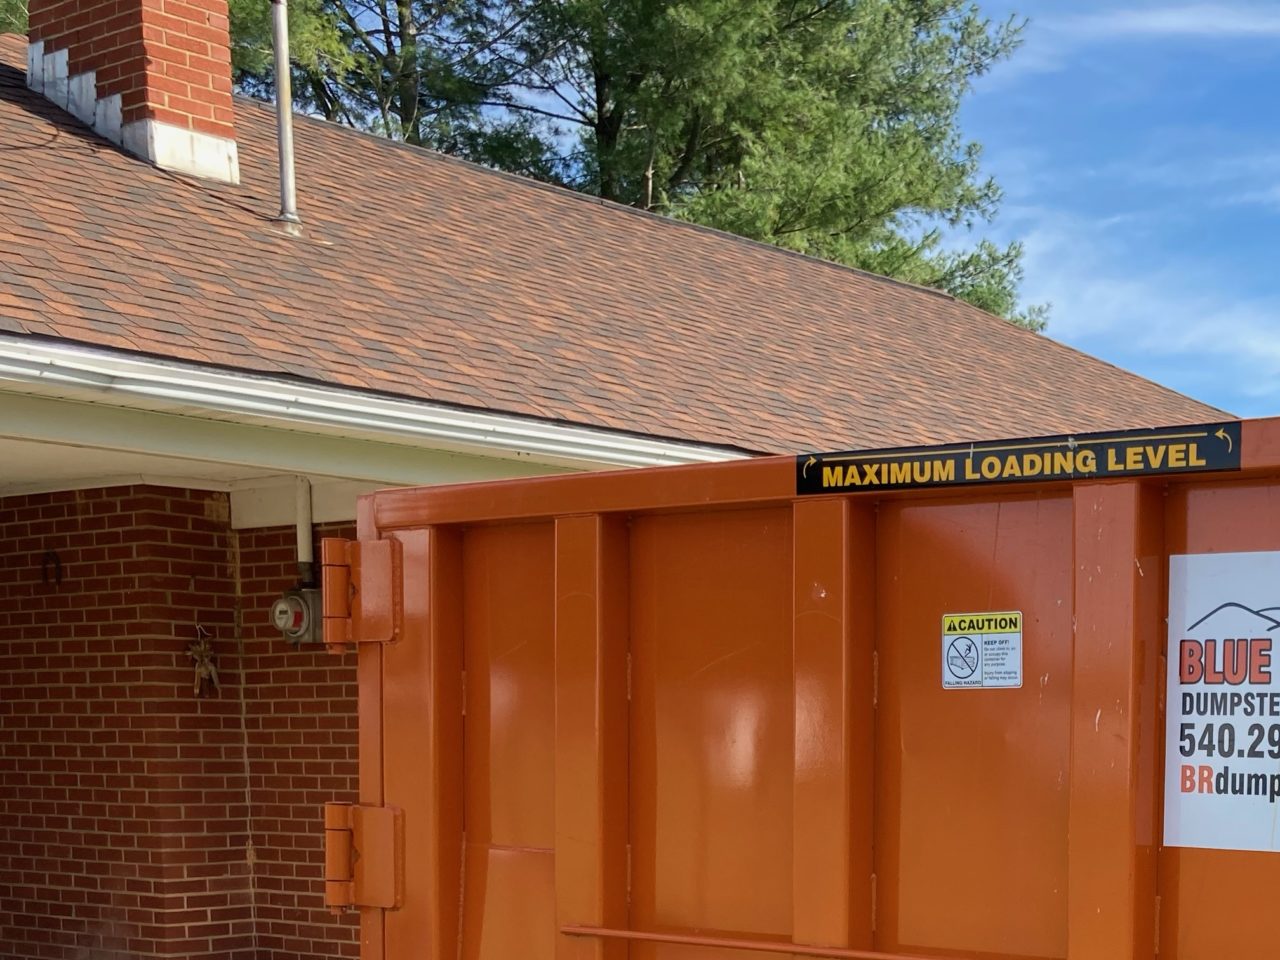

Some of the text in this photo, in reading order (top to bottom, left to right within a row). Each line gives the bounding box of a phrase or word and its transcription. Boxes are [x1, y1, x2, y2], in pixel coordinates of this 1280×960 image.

[822, 443, 1206, 488] MAXIMUM LOADING LEVEL
[958, 617, 1018, 631] CAUTION
[1179, 638, 1272, 685] BLUE
